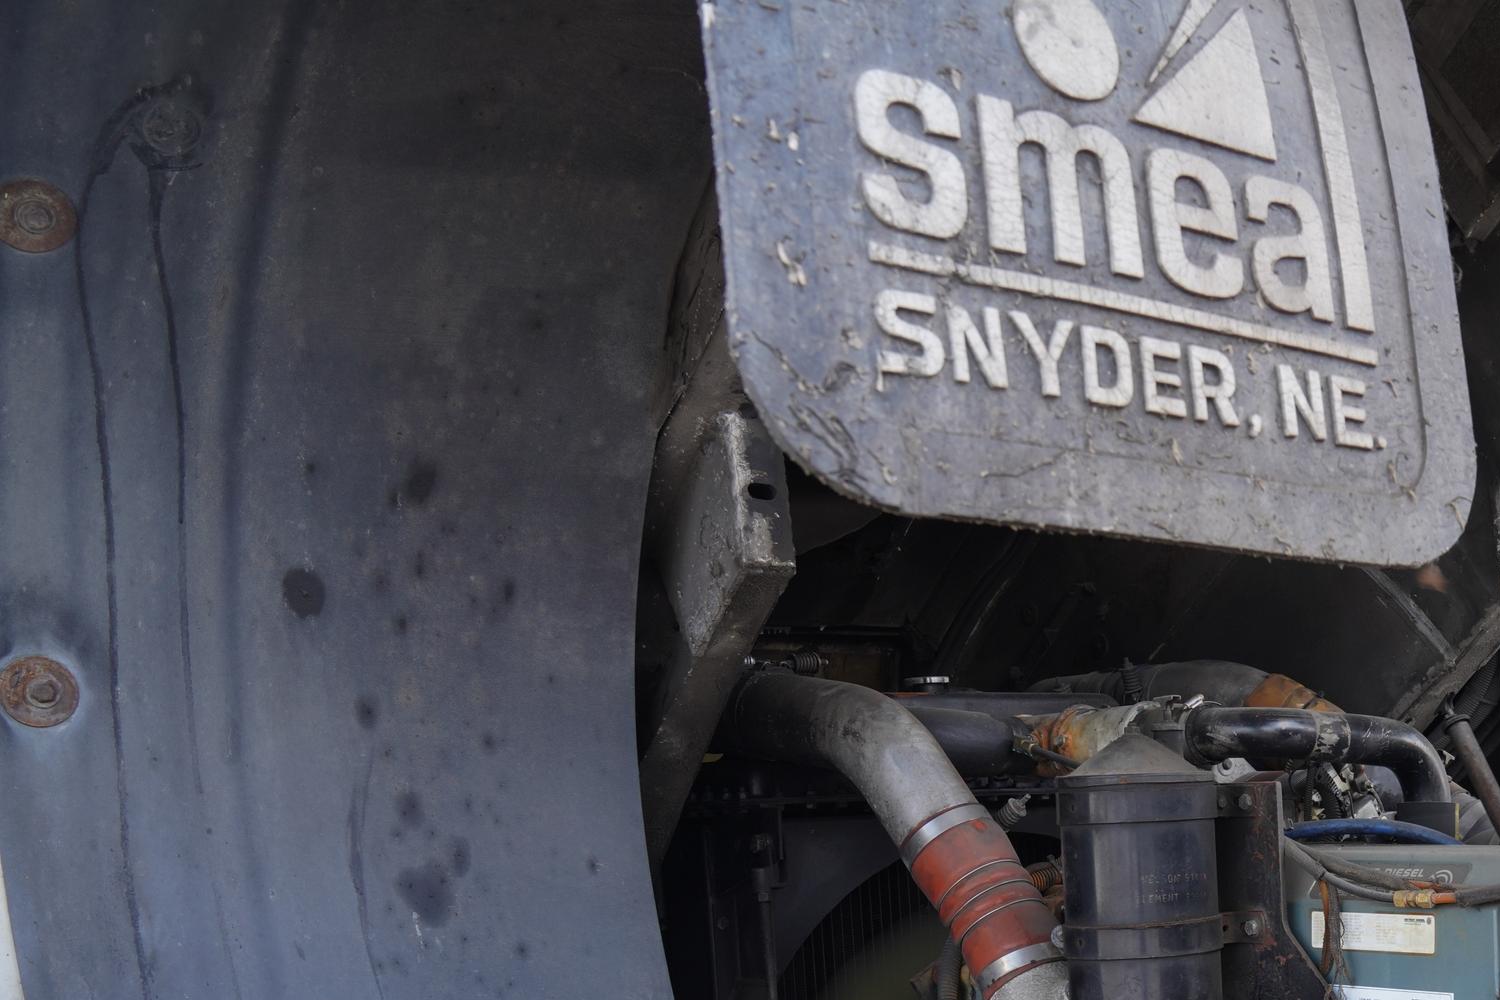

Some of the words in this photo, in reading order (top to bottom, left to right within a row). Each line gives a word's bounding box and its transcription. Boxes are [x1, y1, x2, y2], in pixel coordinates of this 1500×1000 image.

[852, 20, 1375, 334] smeal
[874, 290, 1263, 439] SNYDER,
[1275, 362, 1388, 451] NE.
